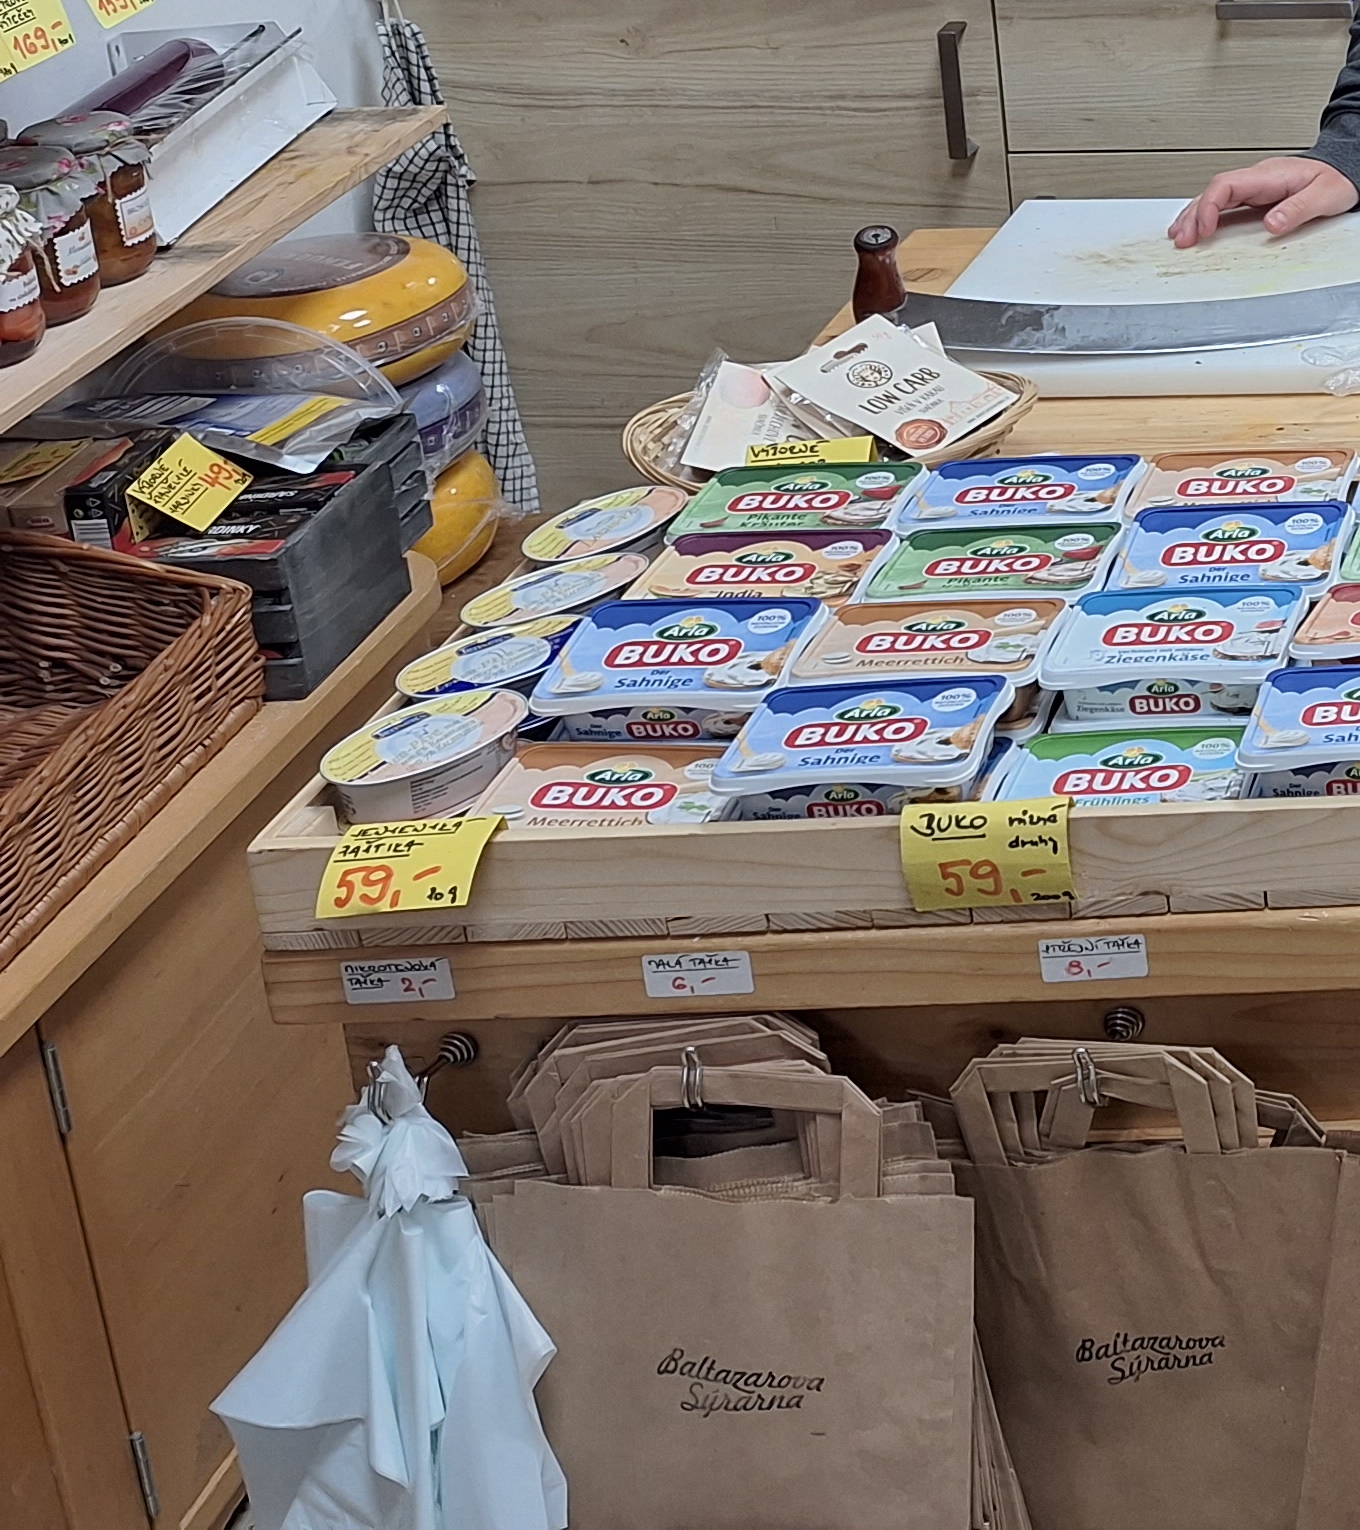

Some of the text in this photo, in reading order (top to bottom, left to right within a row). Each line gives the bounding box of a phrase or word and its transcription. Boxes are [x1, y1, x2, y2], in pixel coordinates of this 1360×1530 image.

[857, 367, 941, 415] LOW CARB
[1006, 473, 1044, 485] Arla
[1225, 467, 1266, 477] Arla
[781, 480, 819, 492] Arla
[961, 485, 1066, 503] BUKO
[1186, 478, 1285, 495] BUKO
[735, 493, 841, 511] BUKO
[1170, 541, 1277, 564] BUKO
[693, 565, 804, 584] BUKO
[932, 555, 1042, 576] BUKO
[1178, 571, 1251, 585] Sahnige
[860, 632, 982, 653] BUKO
[1110, 624, 1225, 646] BUKO
[613, 642, 730, 666] BUKO
[855, 654, 966, 668] Meerrettich
[1103, 650, 1211, 664] Ziegenkäse
[613, 675, 694, 689] Sahnige
[1133, 695, 1196, 713] BUKO
[646, 711, 672, 721] Arla
[631, 722, 696, 738] BUKO
[798, 752, 882, 767] Sahnige
[595, 768, 644, 783] Arla
[537, 785, 665, 809] BUKO
[1007, 834, 1059, 855] druhy
[333, 864, 442, 909] 59,-
[938, 858, 1047, 904] 59,-
[1065, 959, 1112, 978] 8,-
[671, 974, 717, 991] 6,-
[1075, 1332, 1226, 1363] Baltazarova
[656, 1347, 825, 1394] Baltazarova
